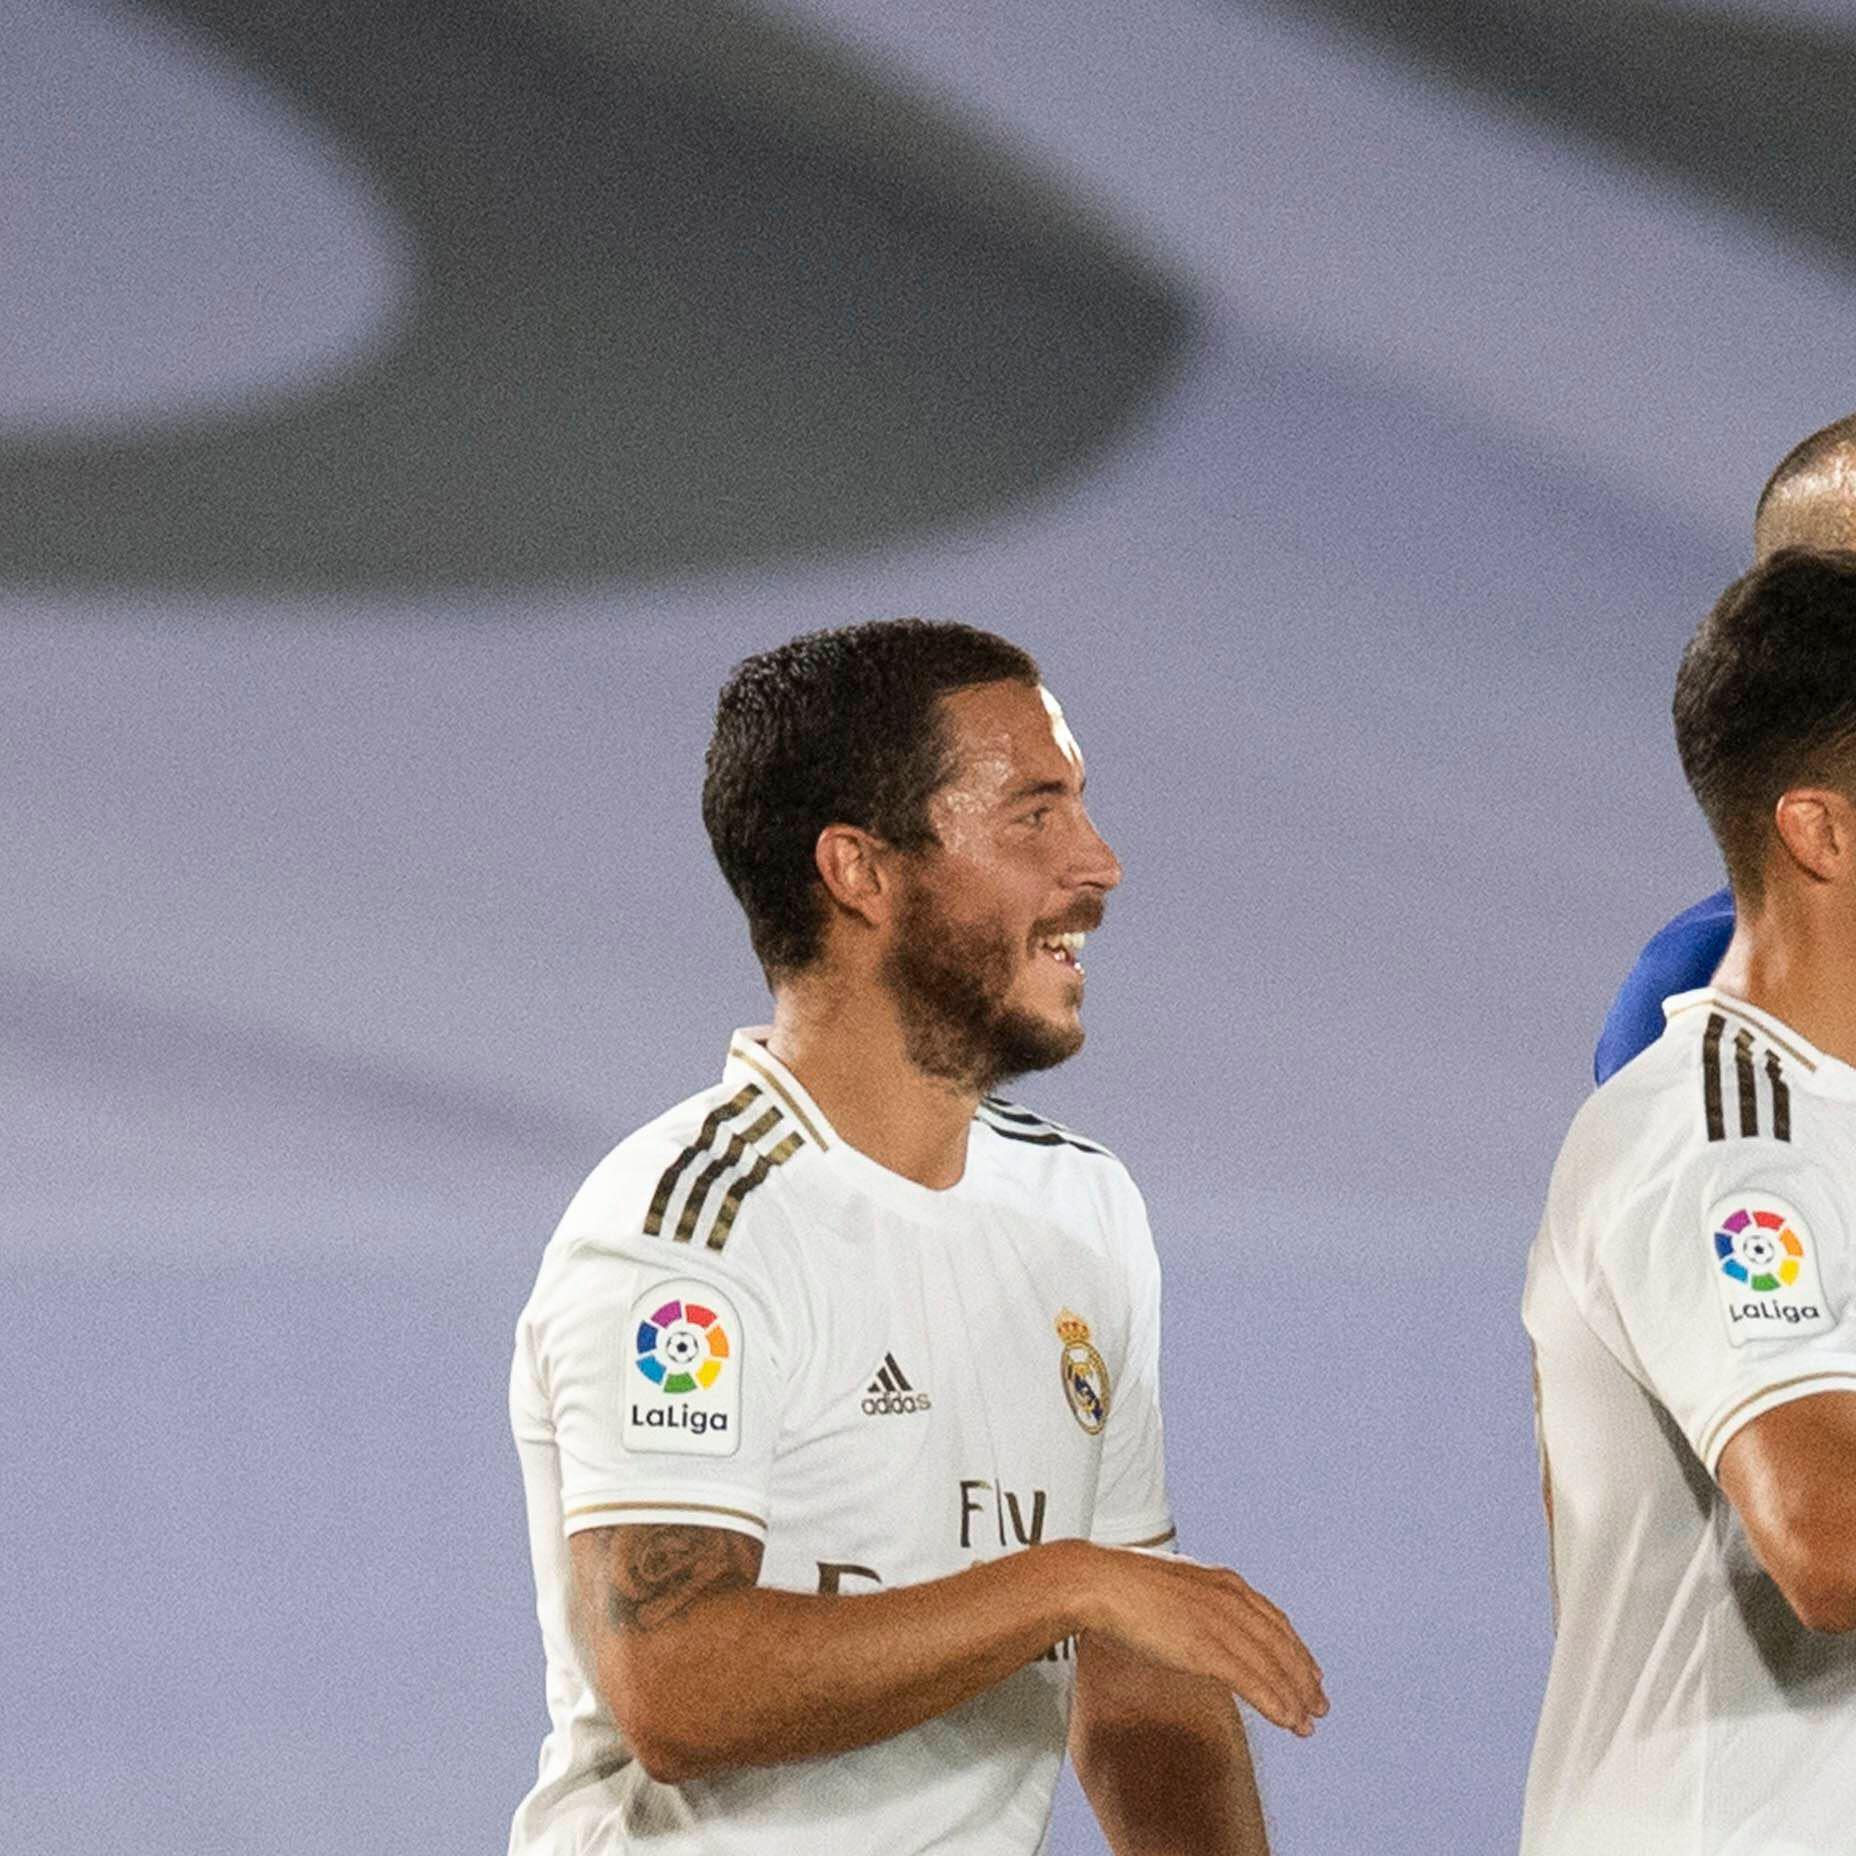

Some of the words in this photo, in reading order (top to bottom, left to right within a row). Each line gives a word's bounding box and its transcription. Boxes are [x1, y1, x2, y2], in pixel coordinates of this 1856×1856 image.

[1729, 1303, 1820, 1328] LaLiga
[861, 1391, 932, 1416] adidas
[631, 1404, 729, 1437] LaLiga
